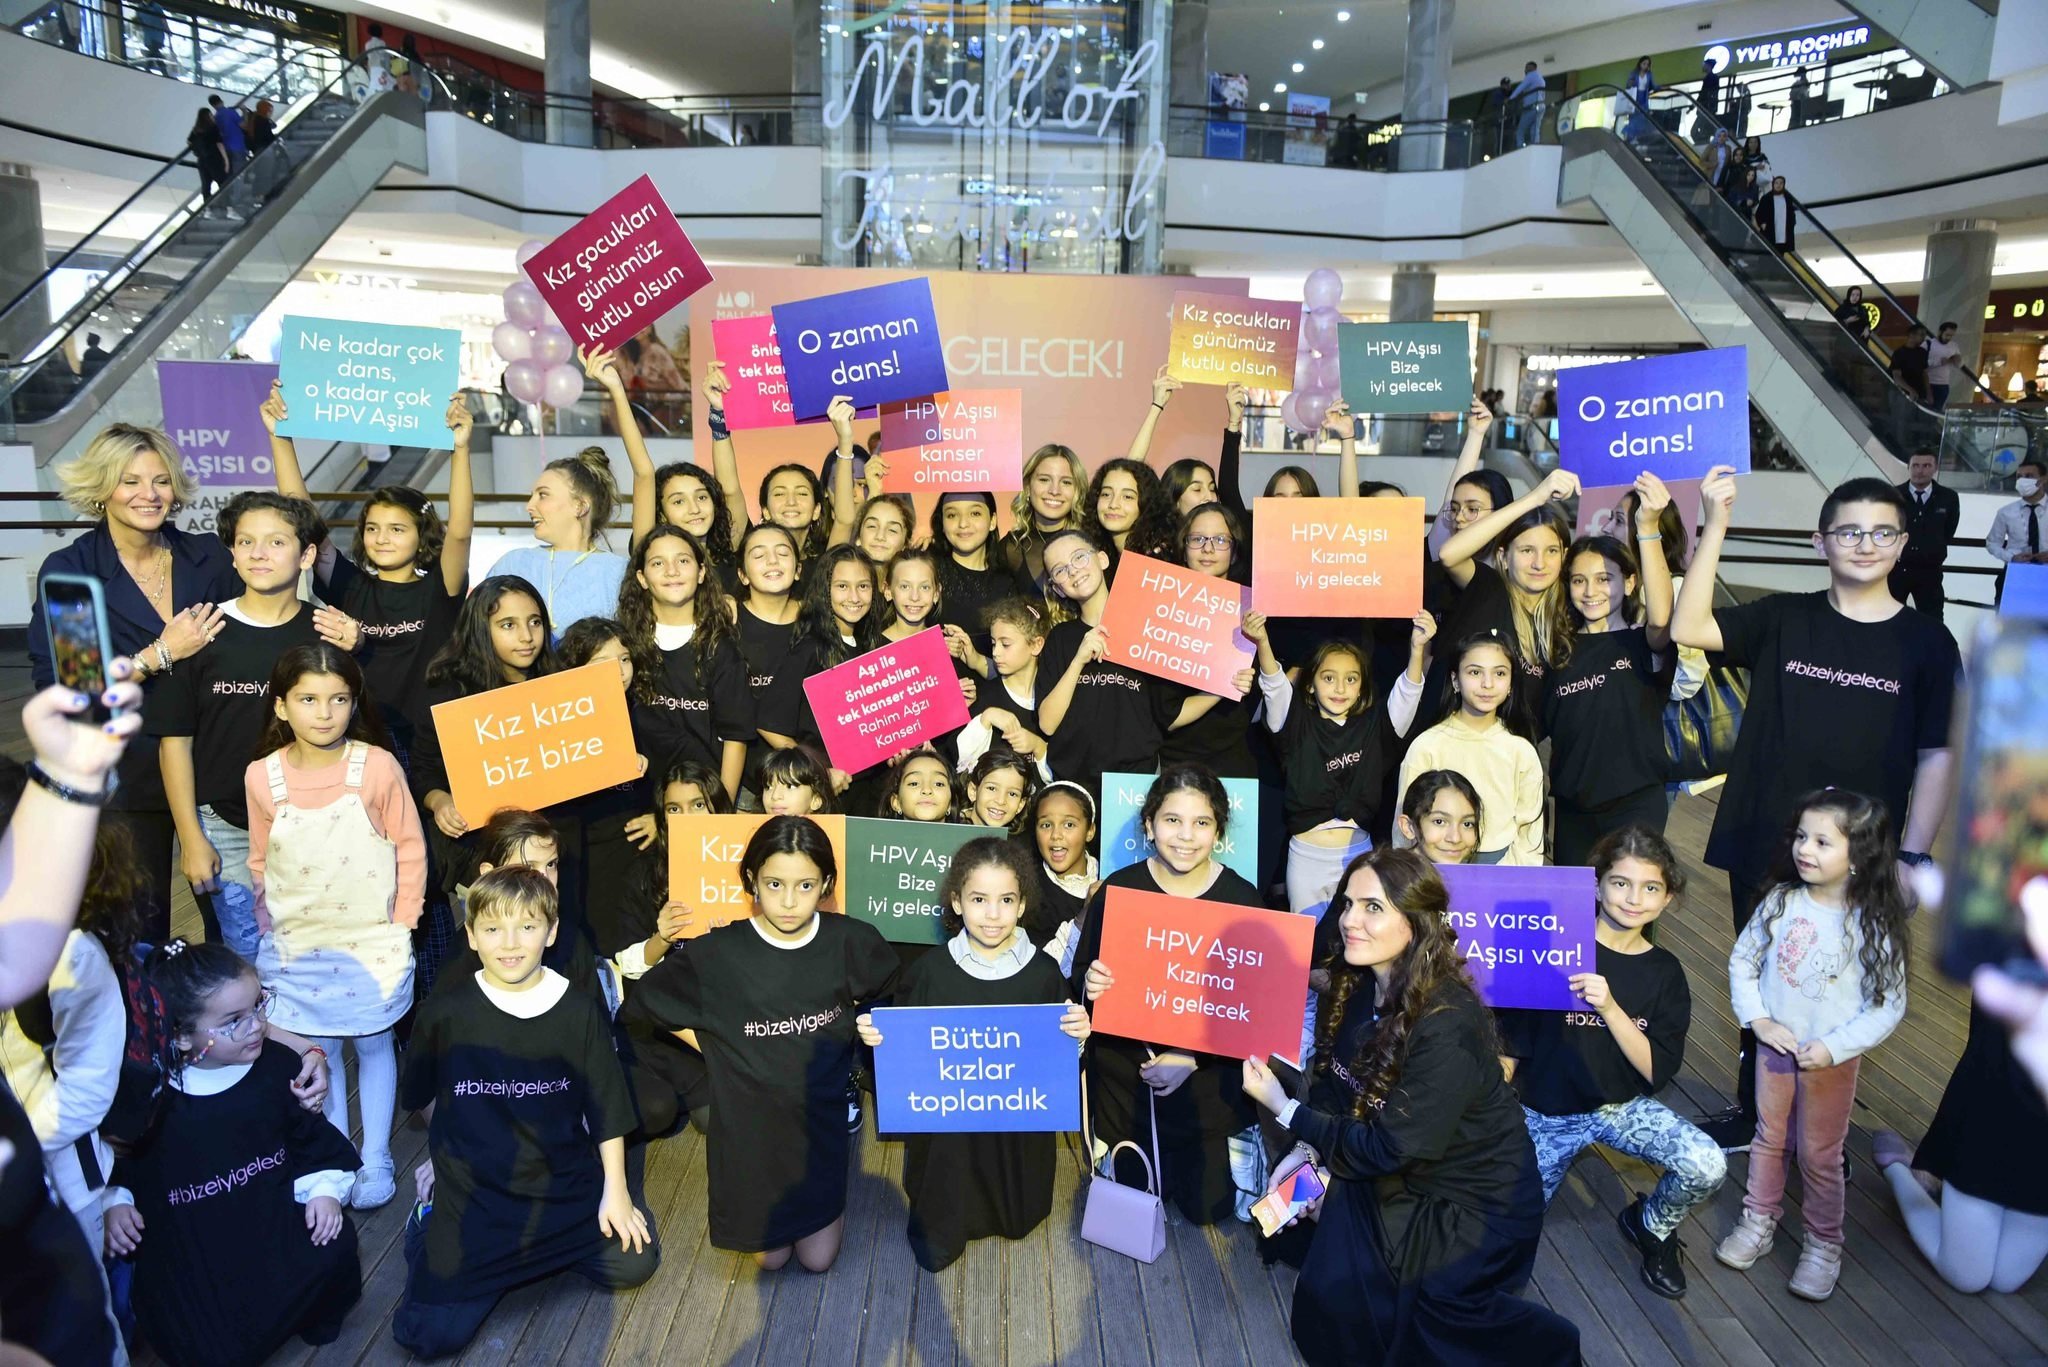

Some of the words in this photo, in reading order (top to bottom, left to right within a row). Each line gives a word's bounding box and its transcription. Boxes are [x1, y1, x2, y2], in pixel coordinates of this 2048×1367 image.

[1736, 42, 1782, 64] YVES
[1788, 27, 1868, 56] ROCHER
[823, 26, 1058, 129] Mall
[1063, 40, 1160, 138] of
[542, 262, 576, 291] Kız
[576, 203, 658, 273] çocukları
[576, 240, 663, 312] günümüz
[581, 302, 633, 341] kutlu
[633, 266, 685, 307] olsun
[1183, 304, 1209, 322] Kız
[1213, 311, 1291, 331] çocukları
[300, 331, 332, 351] Ne
[338, 335, 401, 358] kadar
[407, 342, 445, 364] çok
[798, 329, 822, 354] O
[828, 317, 919, 350] zaman
[1192, 331, 1276, 353] günümüz
[1366, 340, 1403, 356] HPV
[1406, 340, 1441, 359] Aşısı
[337, 359, 397, 383] dans,
[738, 363, 762, 378] tek
[831, 350, 901, 385] dans!
[944, 336, 1124, 378] GELECEK!
[1181, 352, 1225, 371] kutlu
[1230, 357, 1277, 377] olsun
[1391, 360, 1420, 374] Bize
[305, 384, 319, 397] o
[326, 381, 389, 404] kadar
[394, 388, 432, 410] çok
[758, 381, 789, 395] Rahi
[1370, 380, 1385, 396] iyi
[1389, 378, 1443, 396] gelecek
[315, 402, 366, 424] HPV
[369, 407, 419, 433] Aşısı
[904, 402, 949, 420] HPV
[954, 402, 998, 424] Aşısı
[1578, 395, 1606, 422] O
[1615, 389, 1724, 419] zaman
[177, 429, 231, 448] HPV
[925, 423, 977, 441] olsun
[1609, 424, 1694, 458] dans!
[182, 456, 245, 478] AŞISI
[251, 456, 275, 474] O
[920, 445, 984, 462] kanser
[914, 466, 990, 483] olmasın
[187, 513, 217, 531] AĞ
[1291, 523, 1338, 542] HPV
[1342, 523, 1388, 547] Aşısı
[1311, 548, 1367, 564] Kızıma
[1141, 569, 1193, 599] HPV
[1192, 586, 1242, 616] Aşısı
[1295, 572, 1313, 589] iyi
[1318, 571, 1382, 589] gelecek
[1155, 602, 1212, 632] olsun
[1142, 618, 1213, 655] kanser
[858, 663, 879, 679] Aşı
[879, 655, 897, 669] ile
[1128, 642, 1211, 681] olmasın
[212, 680, 270, 697] #bizeiyi
[845, 665, 921, 703] önlenebilen
[1785, 660, 1901, 695] #bizeiyigelecek
[837, 709, 861, 726] tek
[861, 690, 905, 716] kanser
[906, 675, 939, 696] türü:
[474, 713, 525, 745] Kız
[531, 695, 596, 729] kıza
[858, 711, 901, 736] Rahim
[903, 699, 930, 717] Ağzı
[875, 719, 923, 748] Kanseri
[483, 756, 533, 787] biz
[539, 736, 603, 771] bize
[1118, 787, 1146, 806] Ne
[701, 835, 744, 862] Kız
[869, 844, 918, 865] HPV
[921, 848, 952, 873] Aşı
[1124, 838, 1137, 850] o
[1212, 836, 1235, 854] ok
[700, 878, 743, 904] biz
[898, 873, 936, 892] Bize
[867, 896, 888, 917] iyi
[1484, 913, 1565, 934] varsa,
[1146, 927, 1203, 956] HPV
[1206, 938, 1263, 969] Aşısı
[1466, 939, 1524, 970] Aşısı
[1531, 943, 1582, 966] var!
[1166, 961, 1235, 991] Kızıma
[1145, 987, 1167, 1010] iyi
[1172, 995, 1250, 1022] gelecek
[930, 1026, 1021, 1050] Bütün
[938, 1057, 1016, 1081] kızlar
[454, 1077, 571, 1098] #bizeiyigelecek
[907, 1086, 1048, 1117] toplandık
[168, 1145, 286, 1206] #bizeiyigelece
